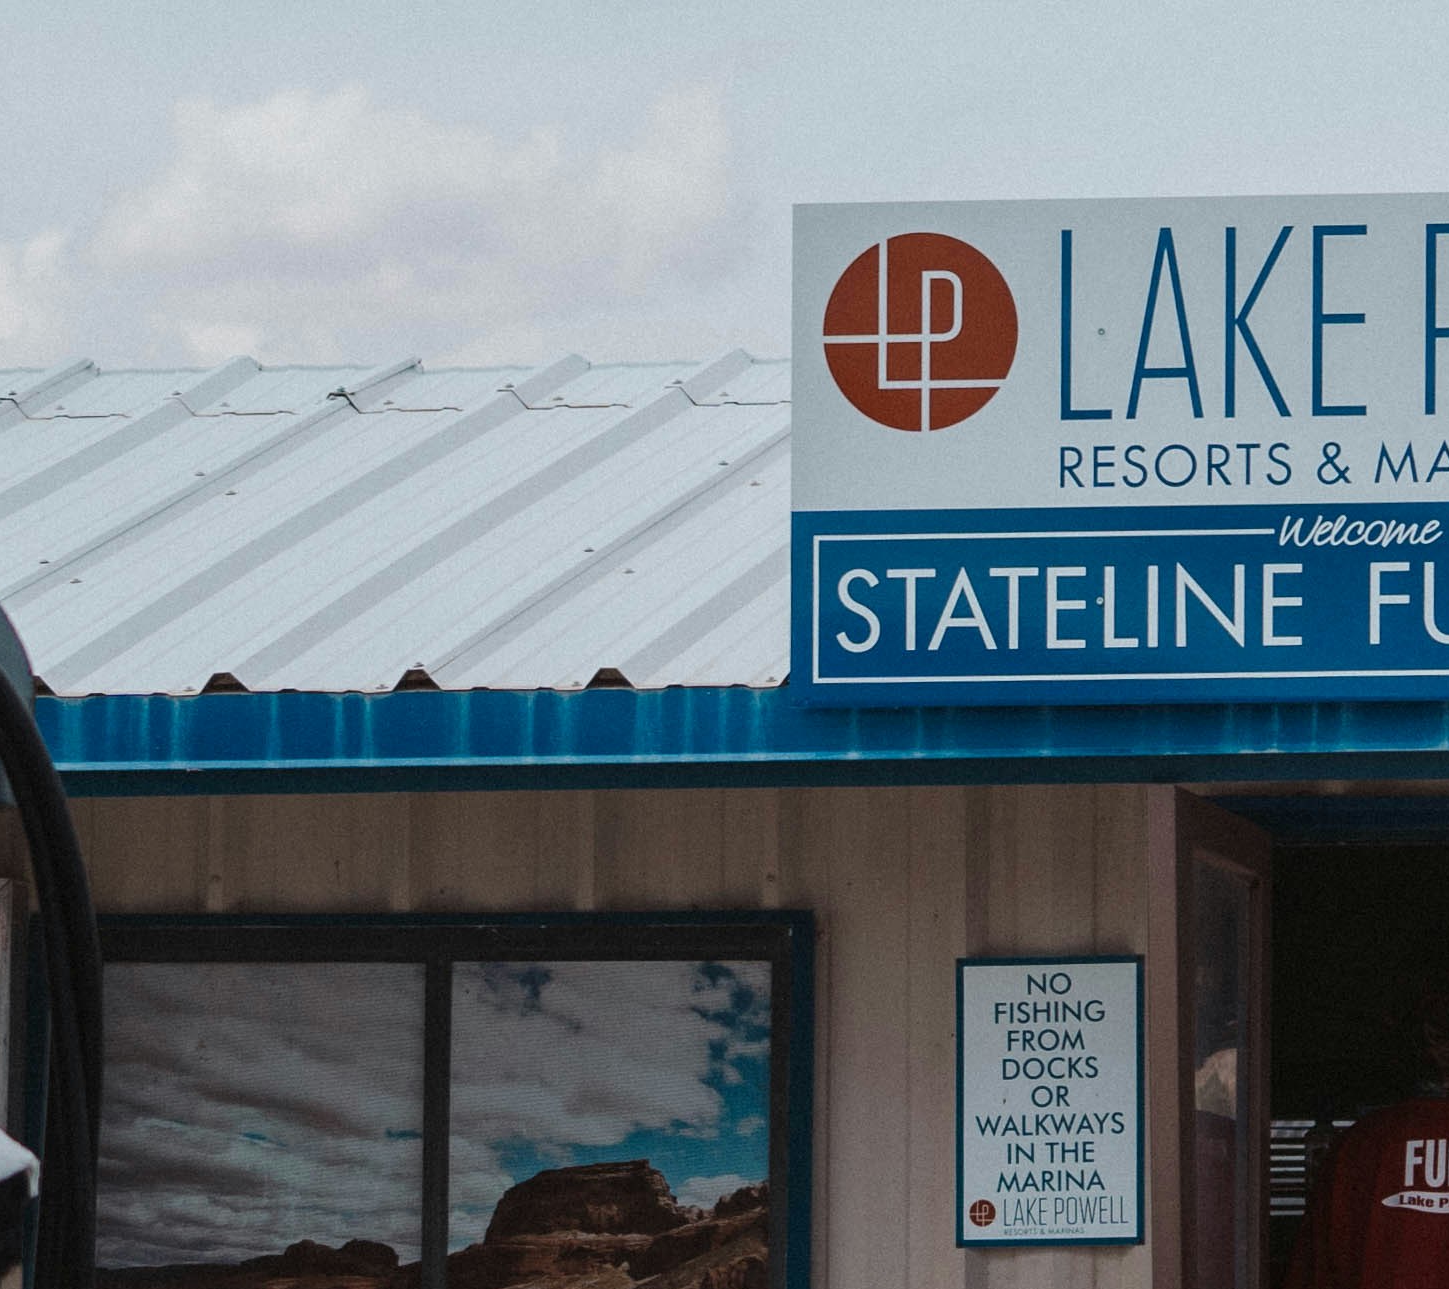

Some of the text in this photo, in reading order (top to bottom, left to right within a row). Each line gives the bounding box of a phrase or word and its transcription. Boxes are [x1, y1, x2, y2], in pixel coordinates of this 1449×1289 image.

[1060, 224, 1368, 421] LAKE
[1059, 442, 1292, 489] RESORTS
[1316, 441, 1351, 485] &
[1278, 514, 1443, 548] Welcome
[836, 562, 1304, 653] STATELINE
[1027, 972, 1072, 995] NO
[994, 1000, 1105, 1024] FISHING
[1007, 1029, 1085, 1052] FROM
[1002, 1056, 1098, 1080] DOCKS
[1031, 1085, 1070, 1108] OR
[975, 1112, 1125, 1136] WALKWAYS
[1007, 1141, 1094, 1164] IN THE
[997, 1170, 1105, 1192] MARINA
[1004, 1196, 1128, 1226] LAKE POWELL
[1398, 1194, 1434, 1208] Lake
